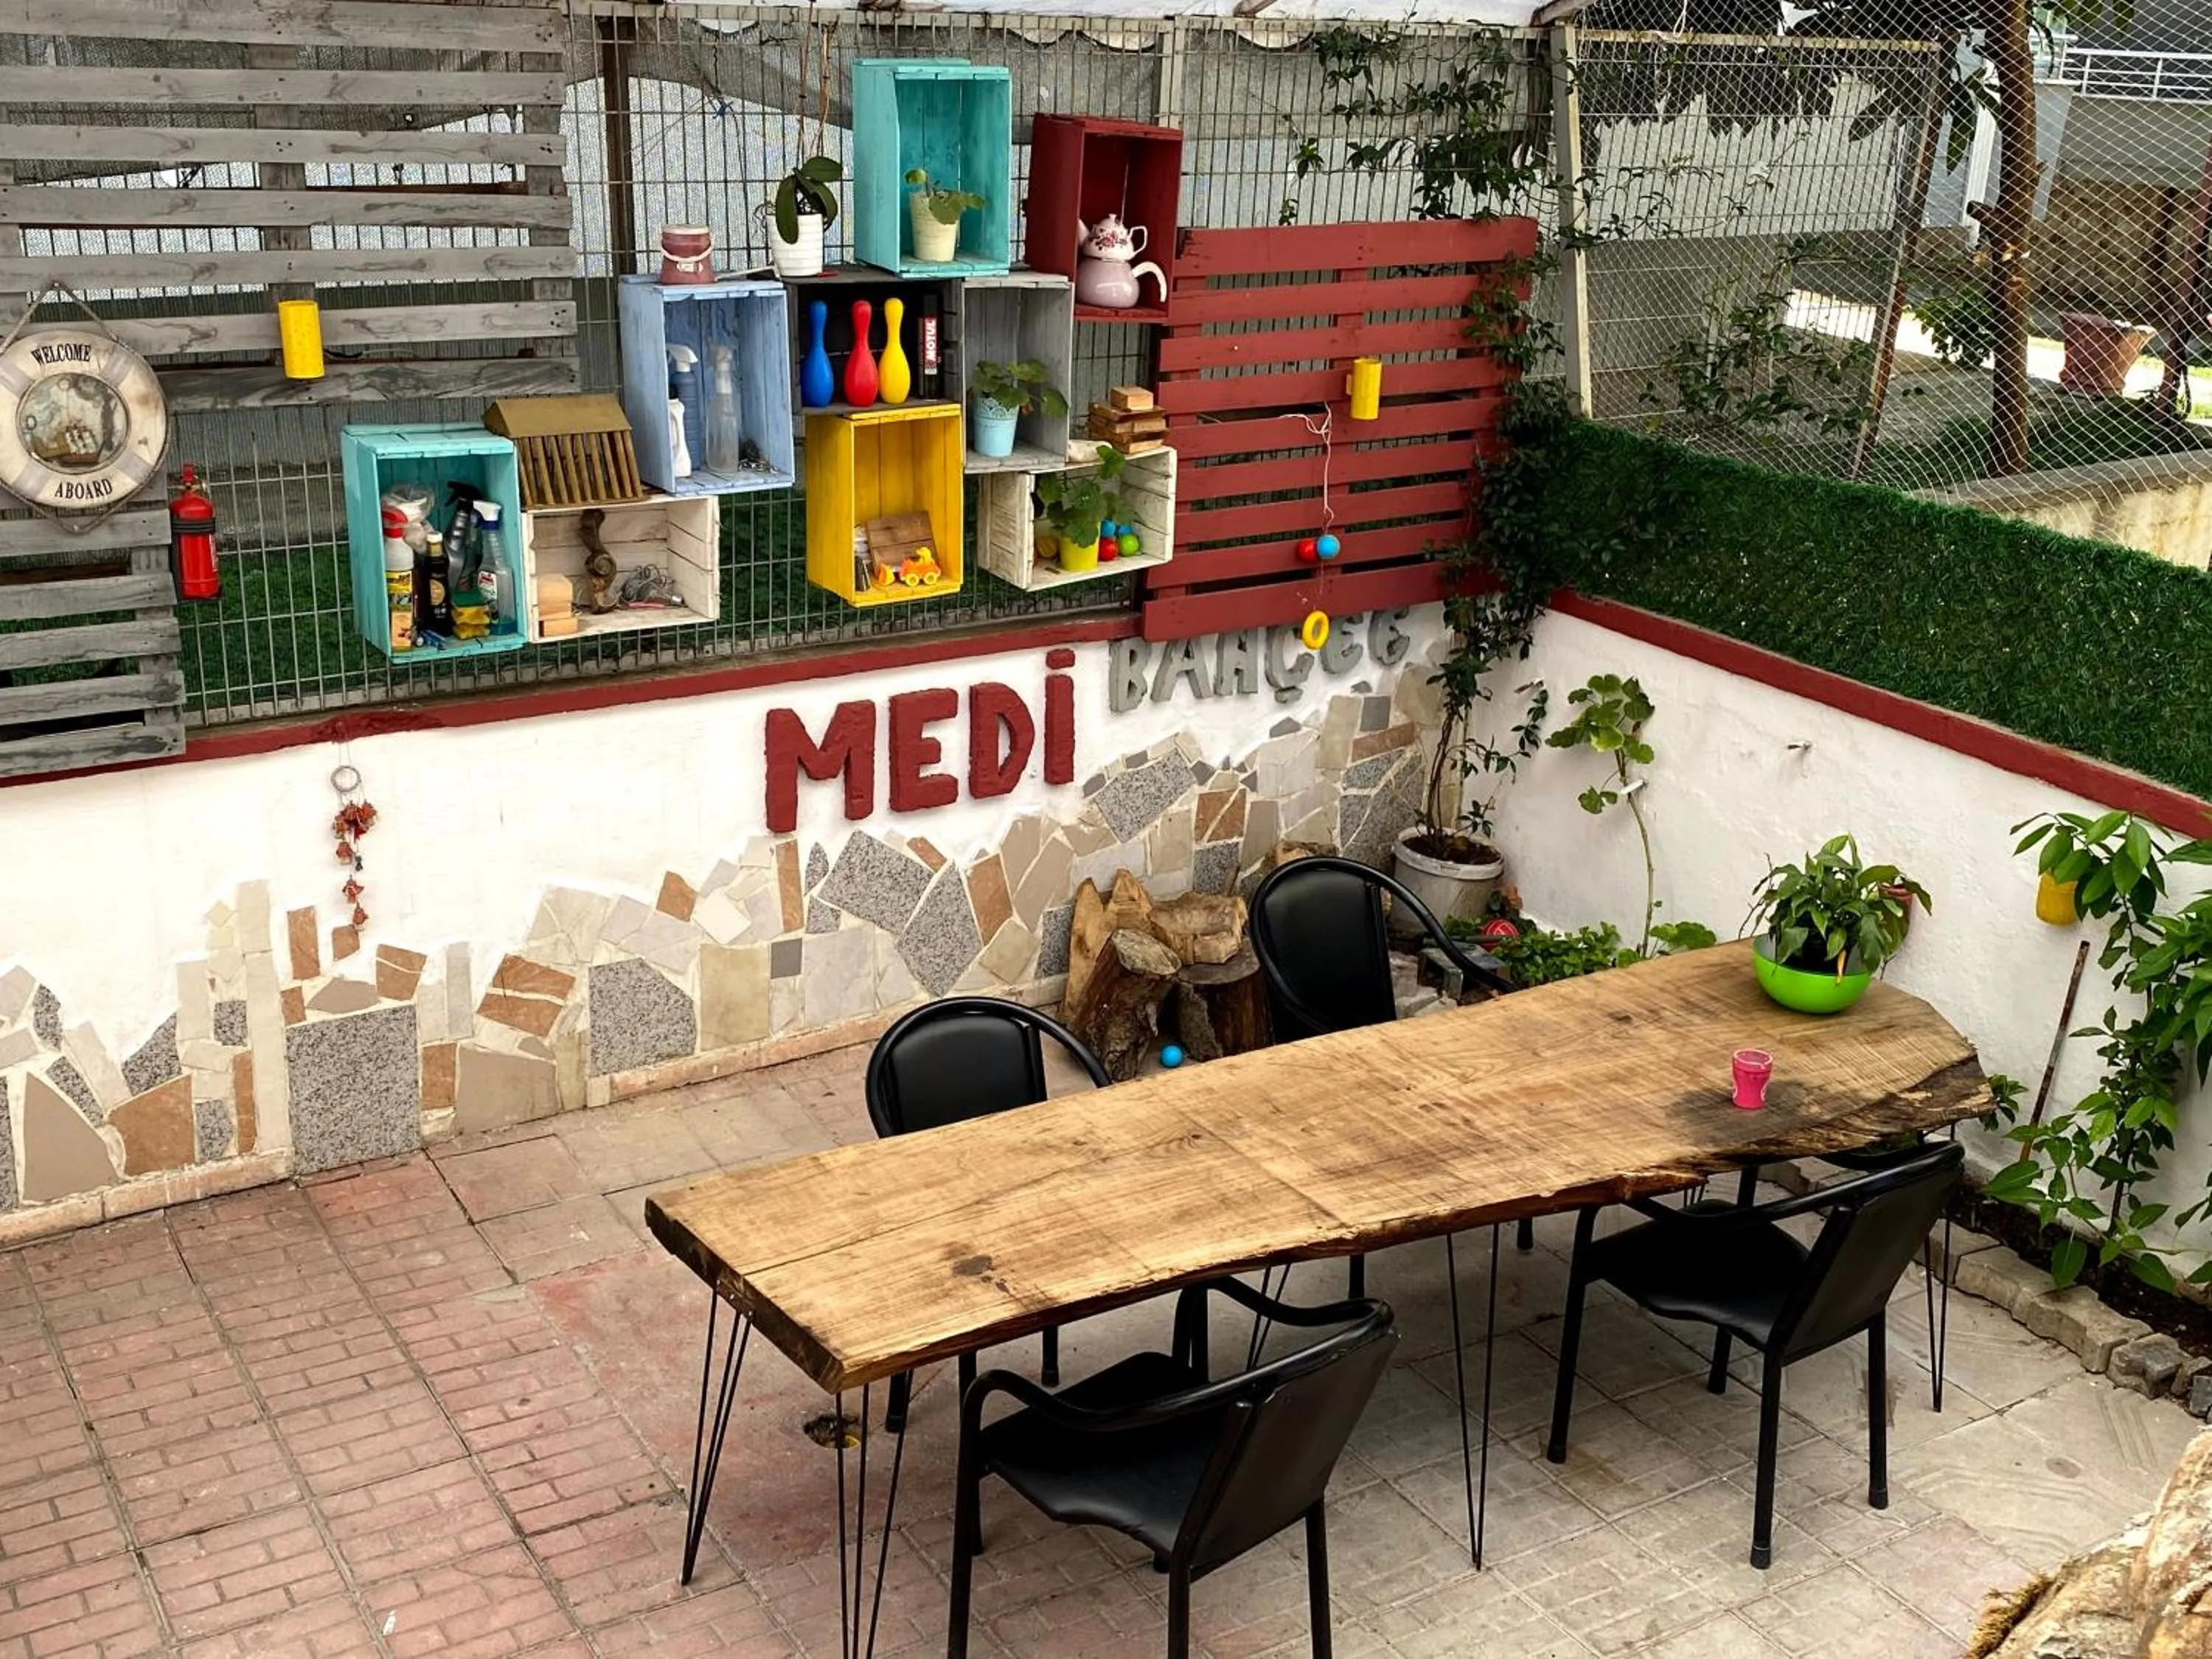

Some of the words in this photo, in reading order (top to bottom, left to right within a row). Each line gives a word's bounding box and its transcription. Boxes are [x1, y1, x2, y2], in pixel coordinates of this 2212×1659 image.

[925, 319, 936, 361] MOTUL
[30, 343, 91, 366] WELCOME
[54, 479, 113, 499] ABOARD
